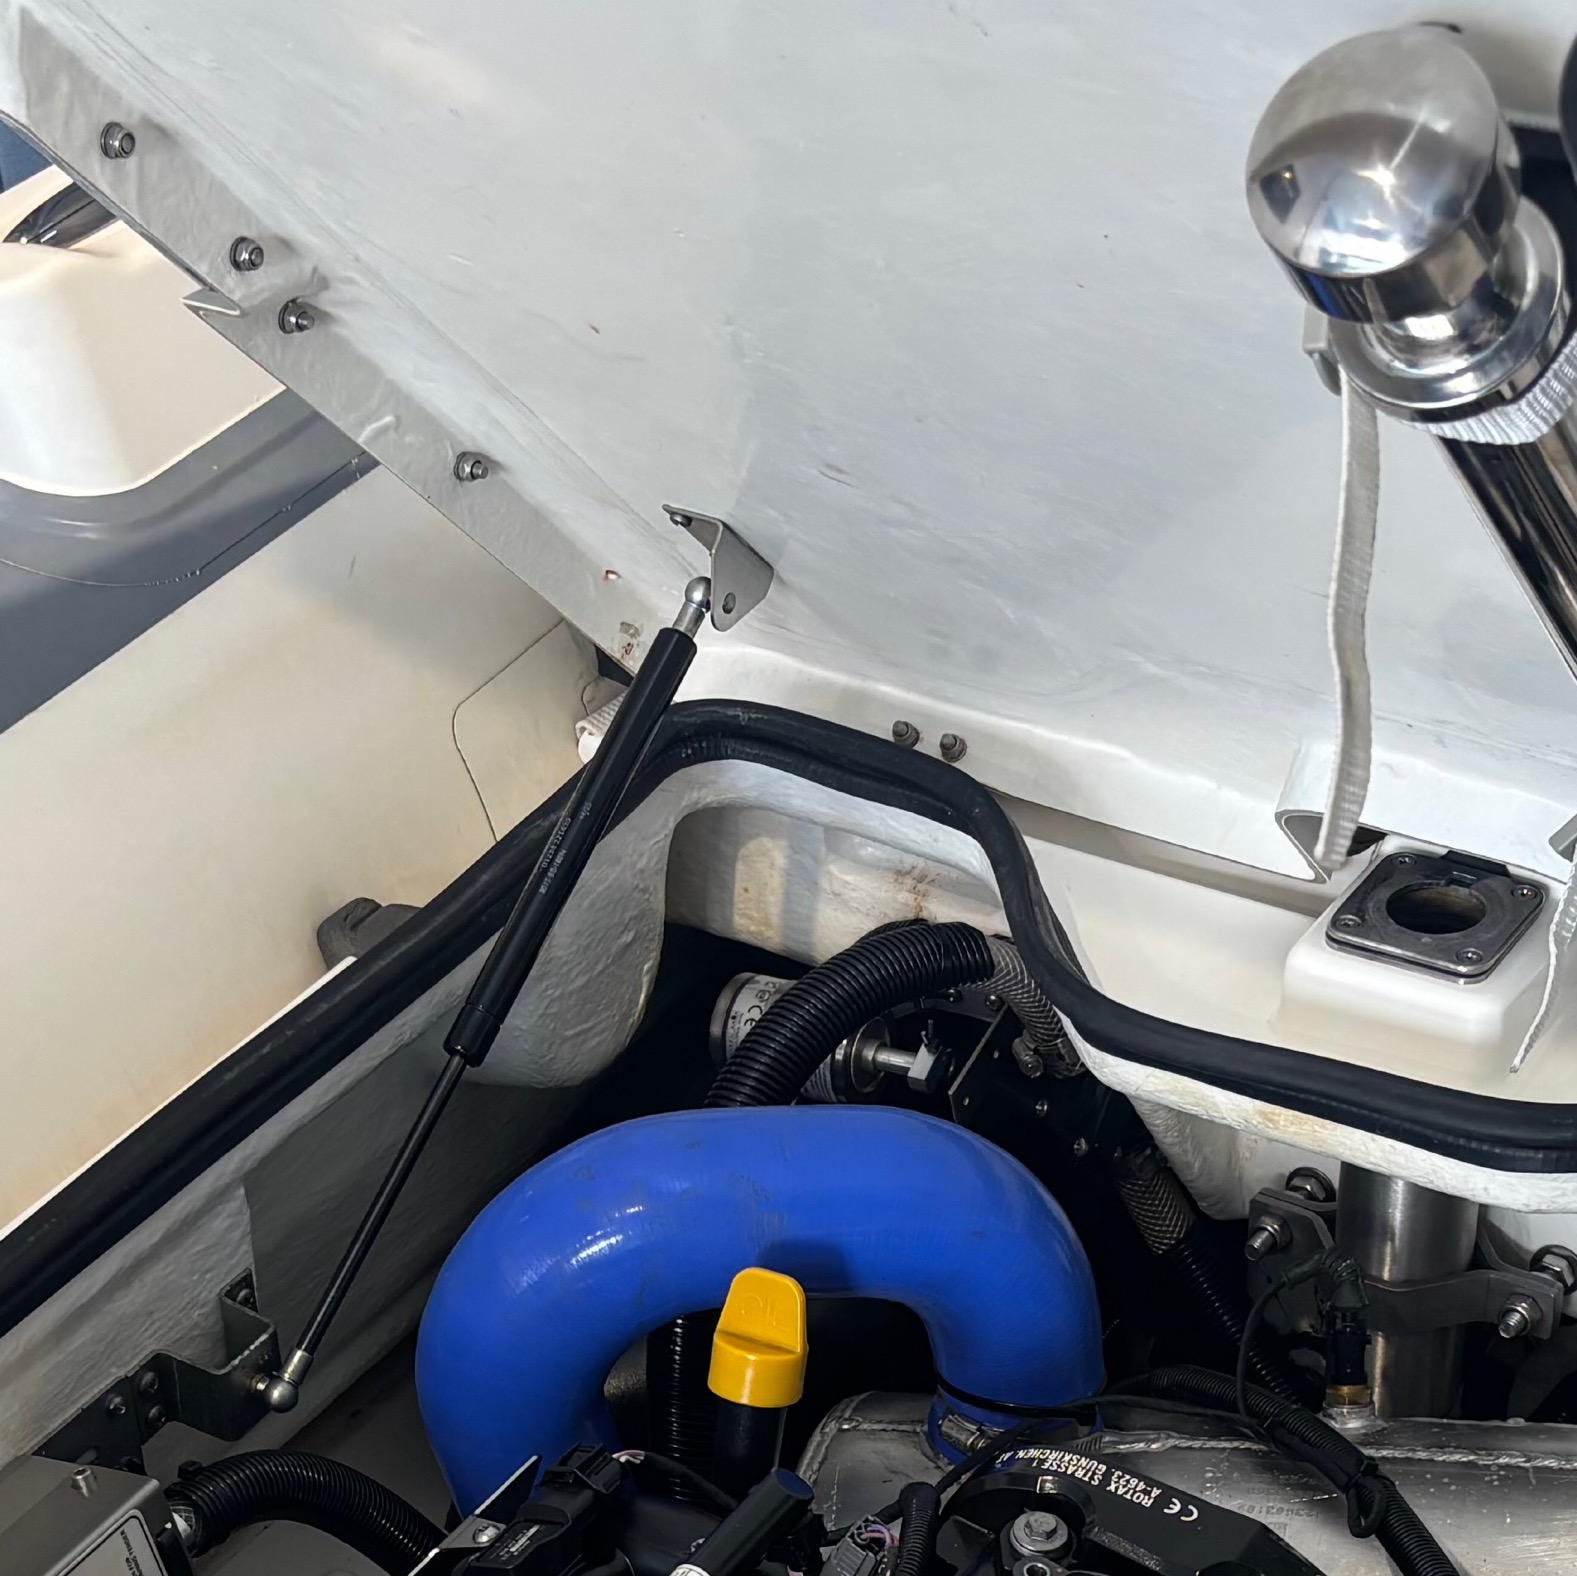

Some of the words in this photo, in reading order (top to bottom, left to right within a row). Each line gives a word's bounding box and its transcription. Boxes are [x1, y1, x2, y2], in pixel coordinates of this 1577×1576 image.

[1040, 1460, 1103, 1486] STRASSE
[1106, 1480, 1156, 1508] ROTAX
[1163, 1498, 1199, 1522] CE
